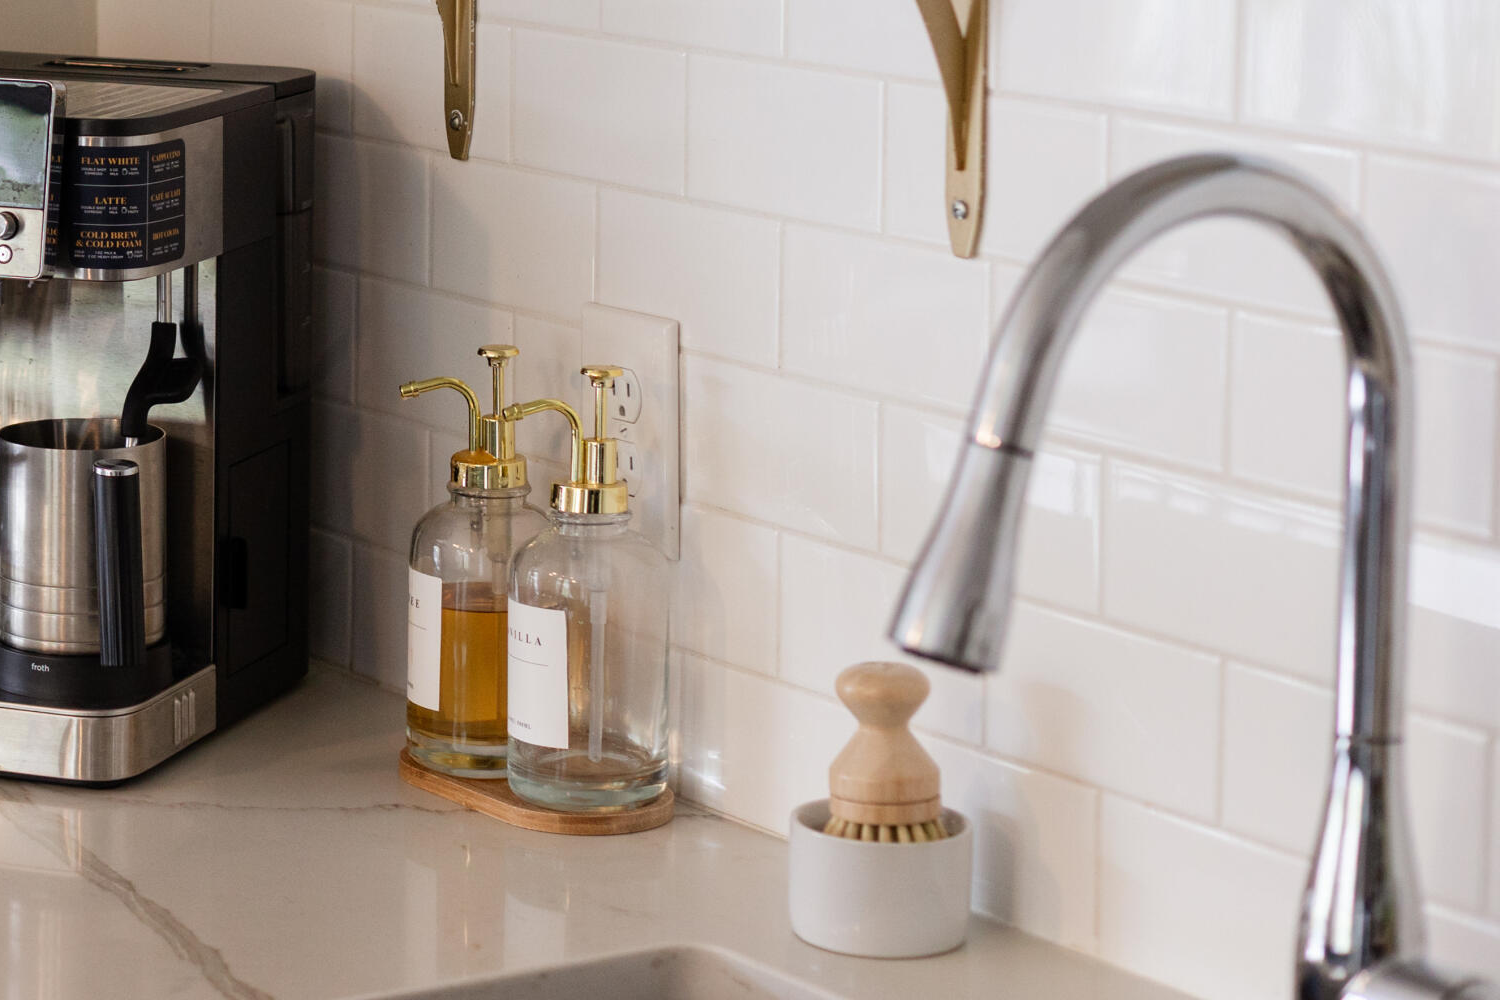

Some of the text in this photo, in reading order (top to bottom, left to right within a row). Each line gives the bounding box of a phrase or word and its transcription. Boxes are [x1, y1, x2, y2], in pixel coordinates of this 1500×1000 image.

[81, 156, 140, 165] FLAT WHITE
[94, 196, 127, 205] LATTE
[80, 231, 139, 239] COLD BREW
[76, 239, 143, 248] & COLD FOAM
[31, 662, 50, 672] froth
